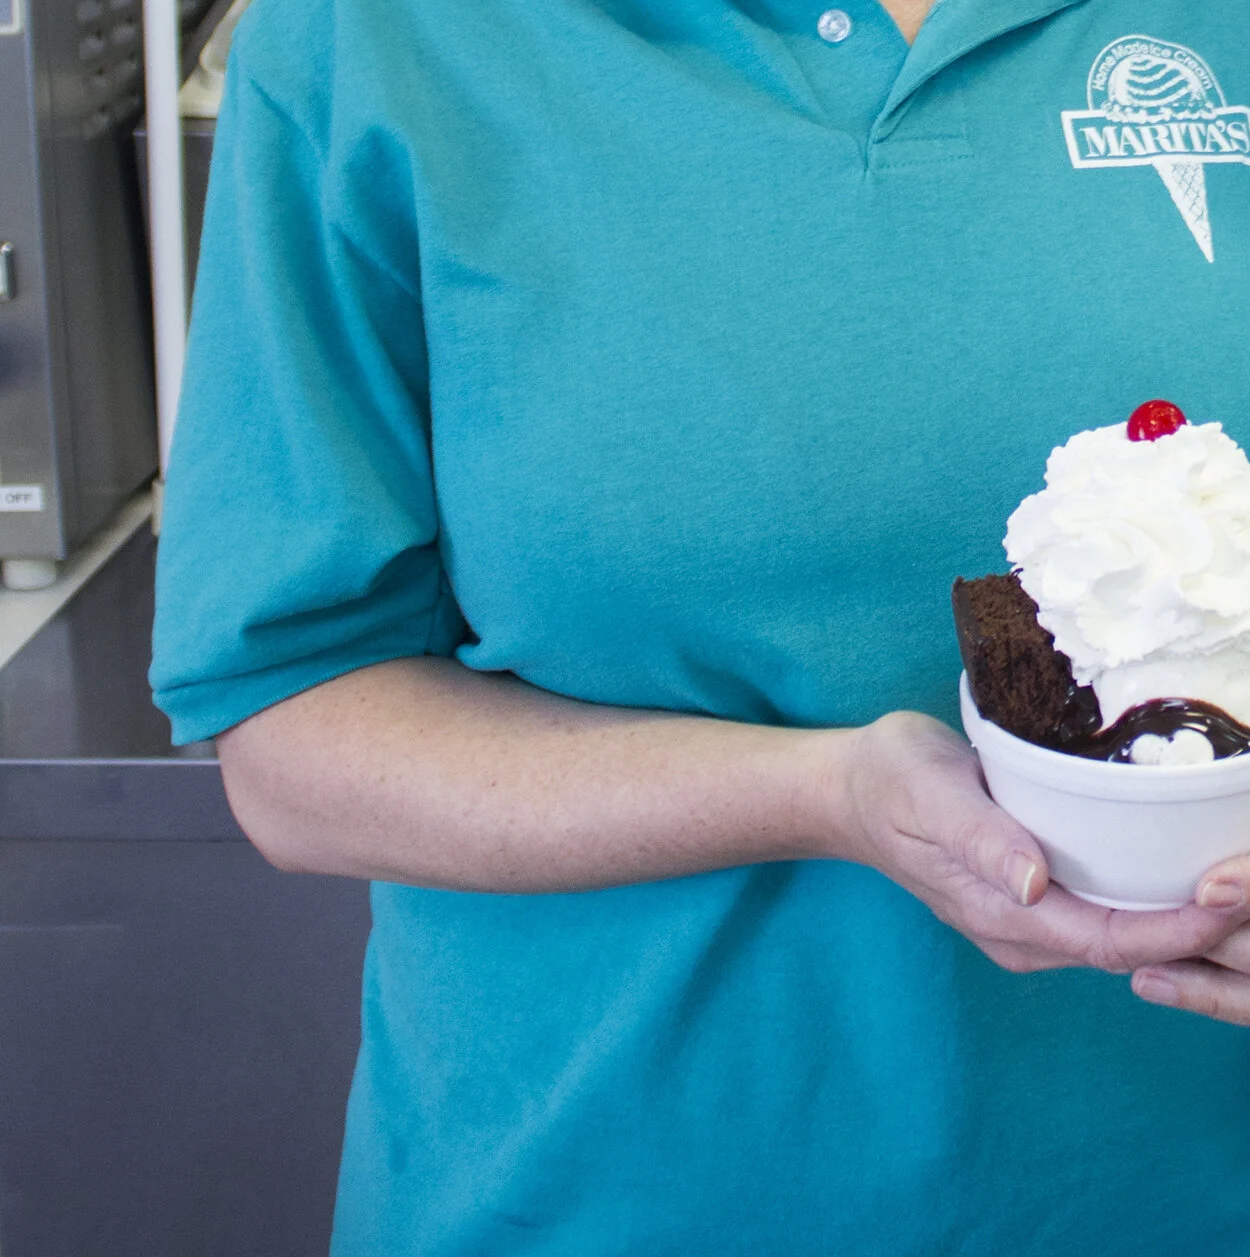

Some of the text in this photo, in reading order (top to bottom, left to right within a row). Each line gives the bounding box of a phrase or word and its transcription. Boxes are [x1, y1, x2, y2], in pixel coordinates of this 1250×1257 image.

[1091, 41, 1213, 91] Home Made Ice Cream
[1079, 119, 1250, 158] MARITA'S
[5, 493, 32, 504] OFF
